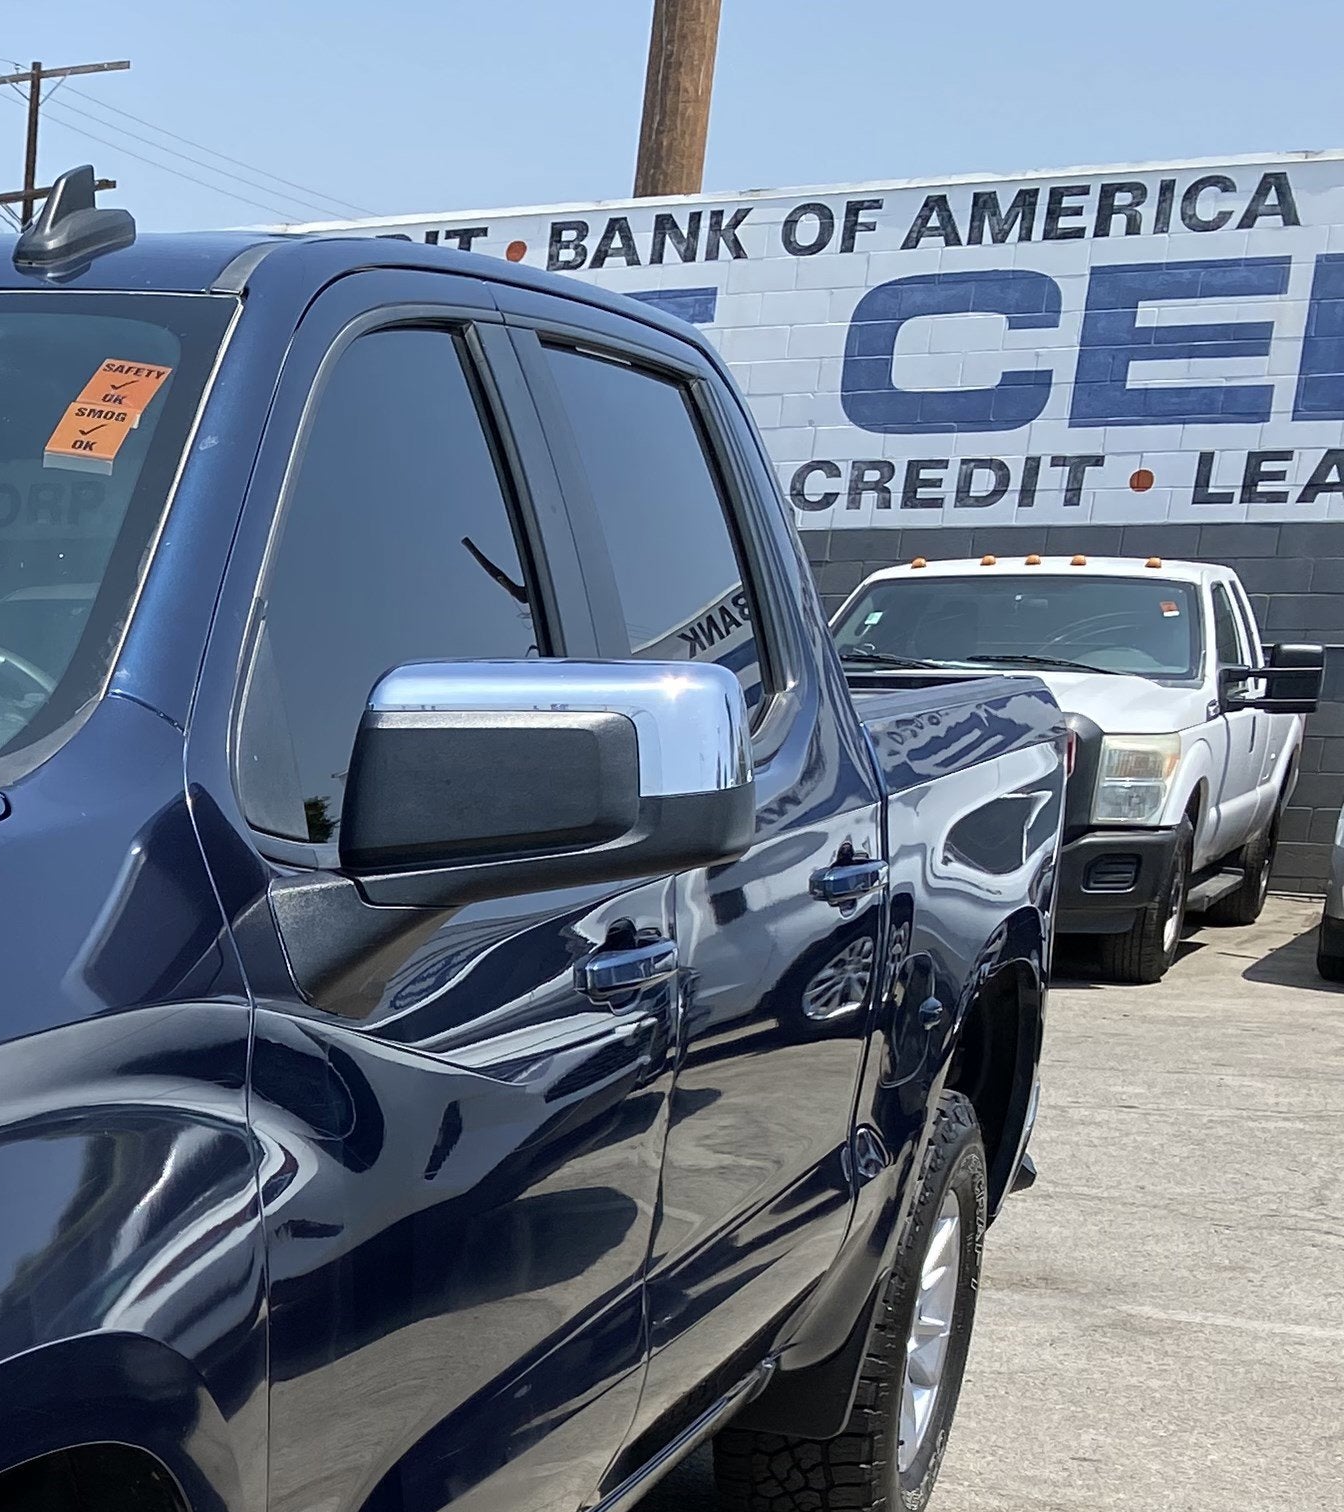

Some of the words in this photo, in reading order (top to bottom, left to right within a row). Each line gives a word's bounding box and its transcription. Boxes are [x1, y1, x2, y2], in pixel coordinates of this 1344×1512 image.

[546, 206, 753, 272] BANK
[781, 197, 884, 257] OF
[900, 171, 1302, 250] AMERICA
[102, 362, 166, 380] SAFETY
[101, 393, 127, 405] OK
[74, 407, 127, 422] SMOG
[70, 438, 98, 452] OK
[789, 454, 1105, 512] CREDIT
